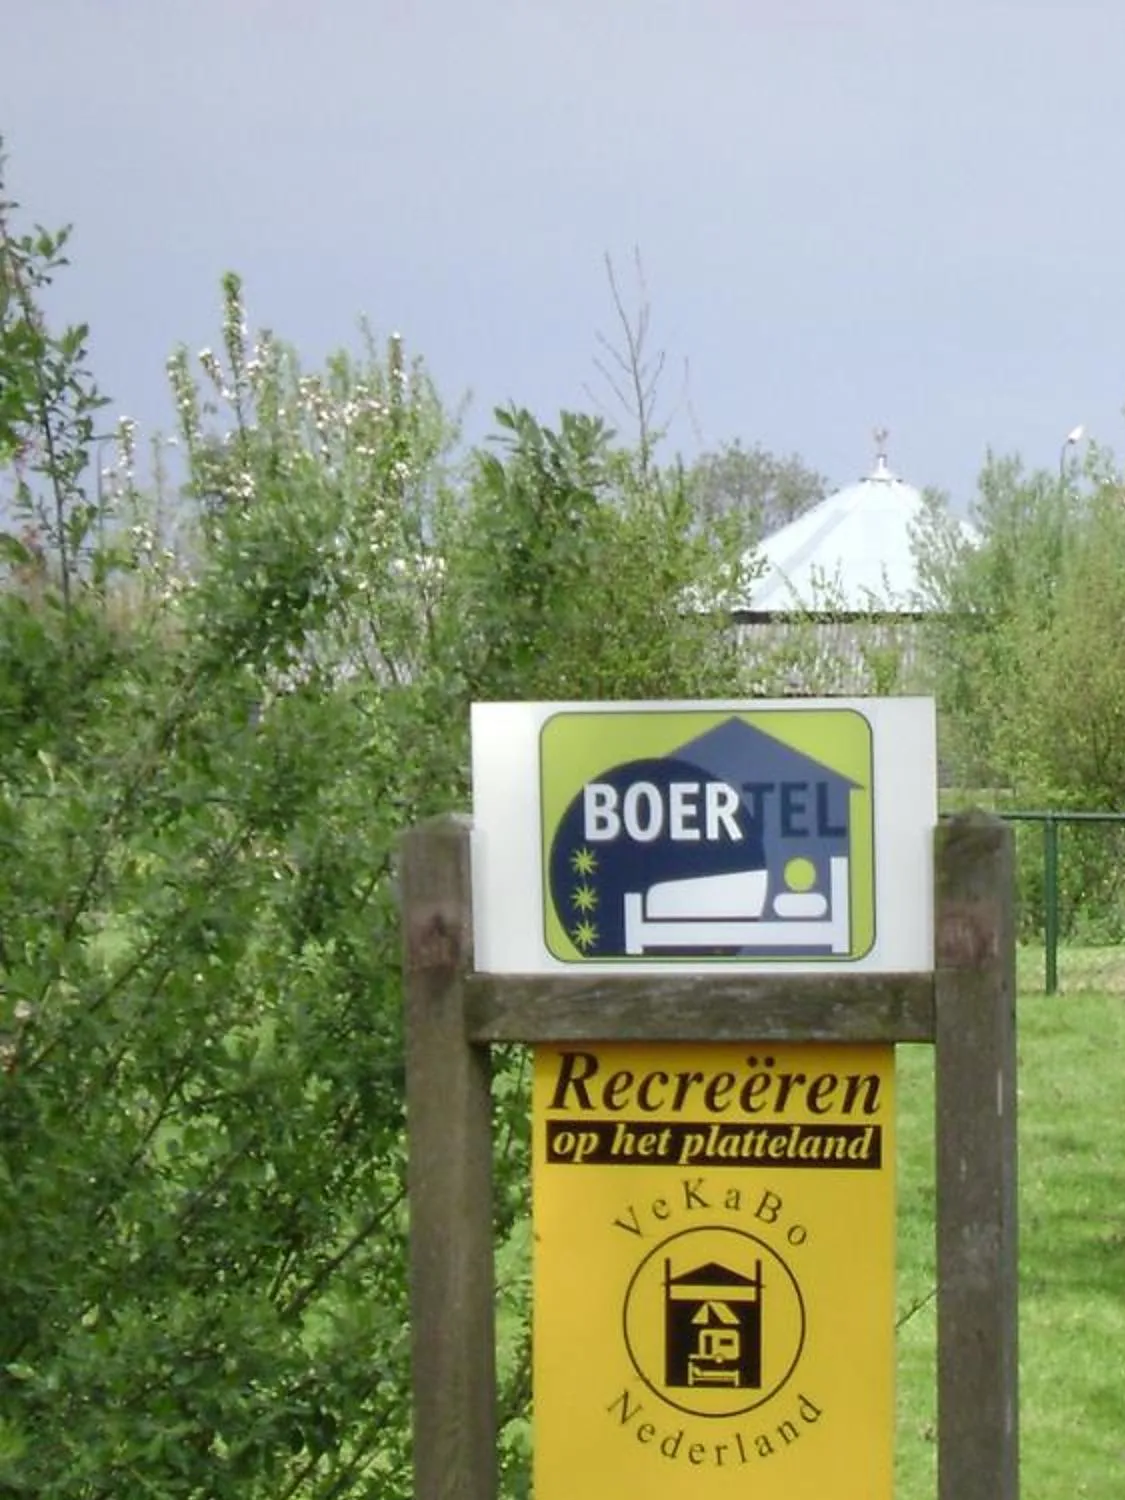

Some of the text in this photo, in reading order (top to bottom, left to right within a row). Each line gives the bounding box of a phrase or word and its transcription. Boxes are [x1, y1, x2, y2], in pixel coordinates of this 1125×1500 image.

[583, 780, 848, 842] BOERTEL
[547, 1051, 881, 1116] Recreëren
[553, 1123, 873, 1165] op het platteland
[612, 1177, 808, 1247] VeKaBo
[607, 1389, 822, 1467] Nederland
